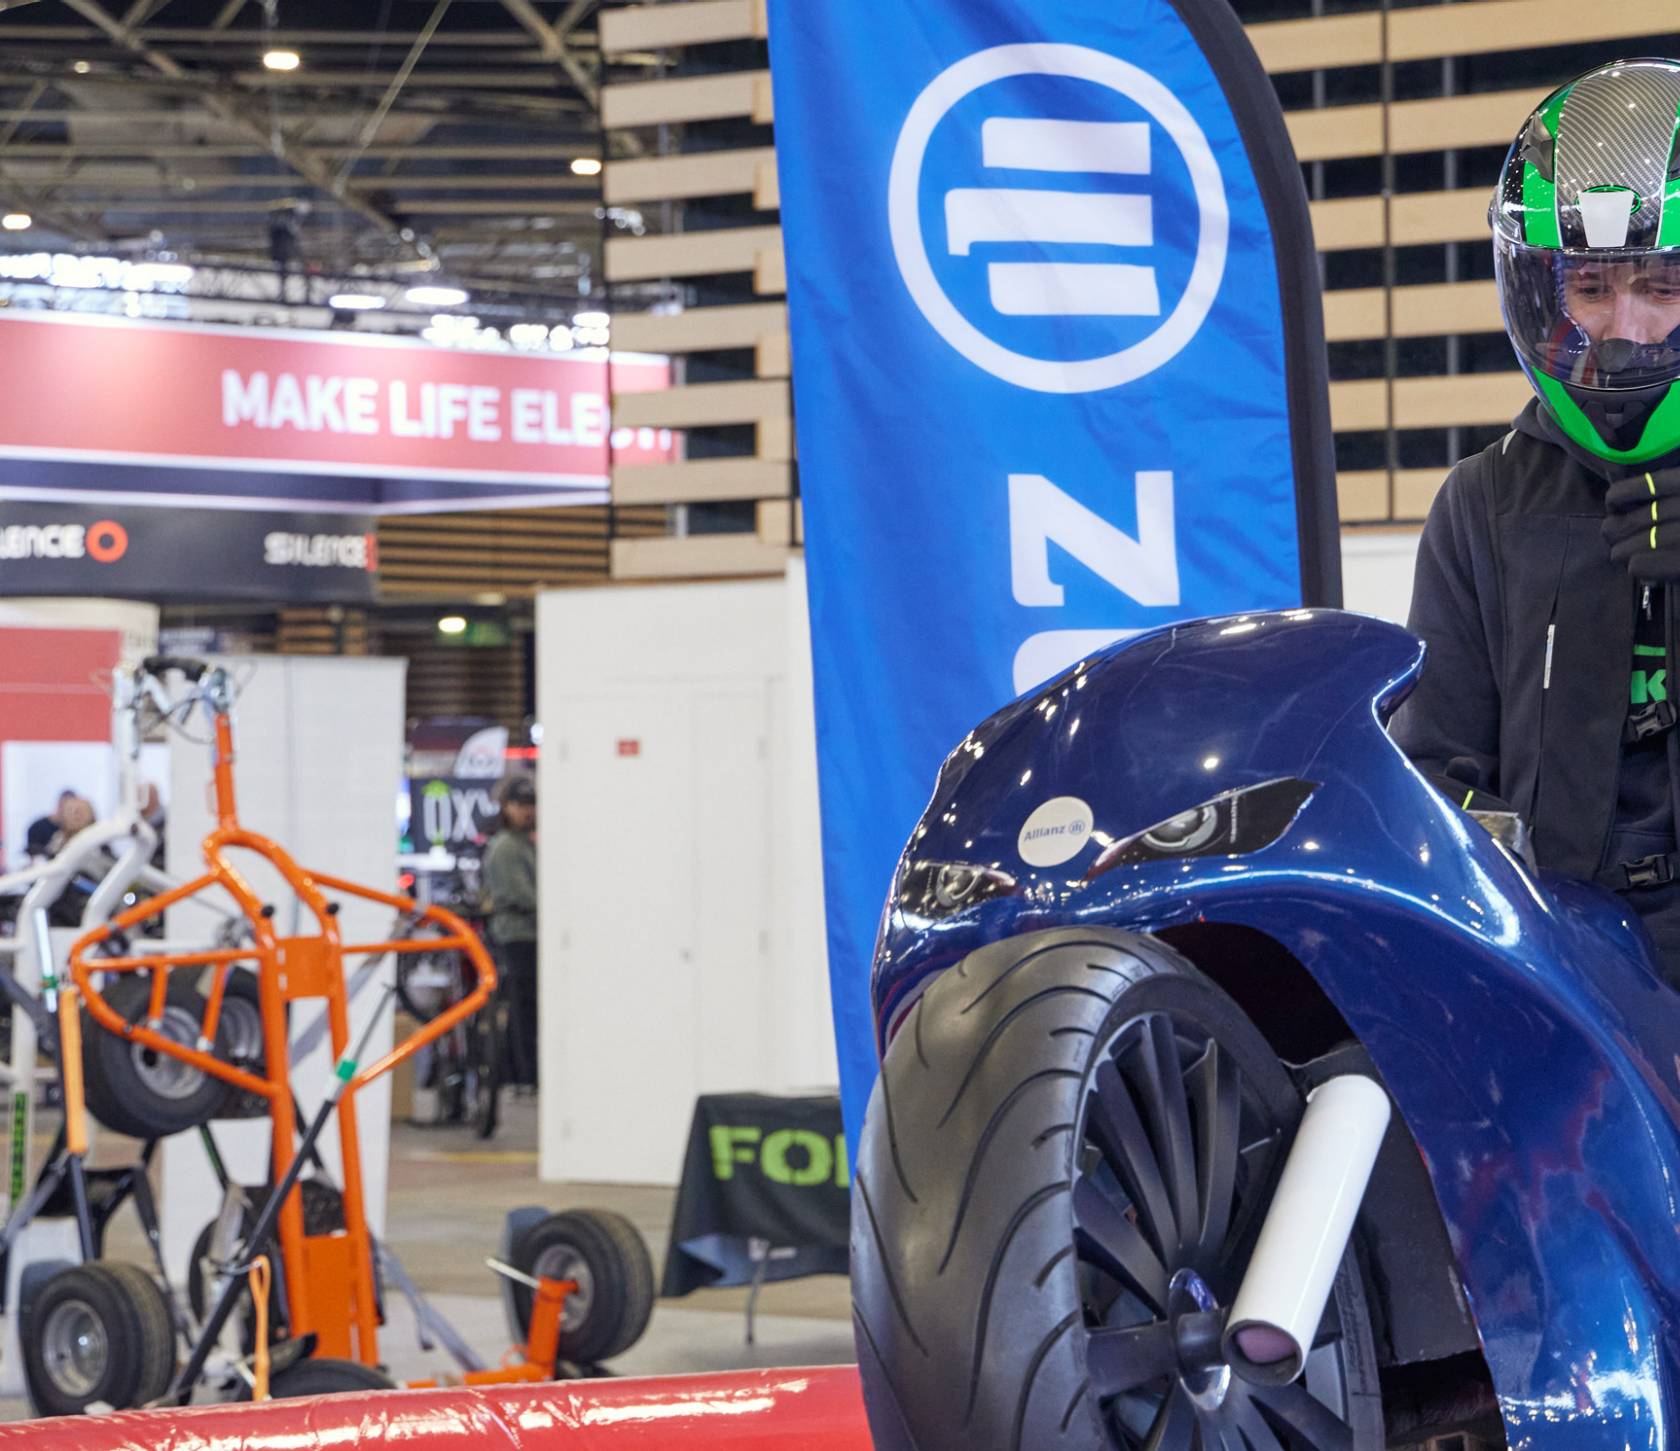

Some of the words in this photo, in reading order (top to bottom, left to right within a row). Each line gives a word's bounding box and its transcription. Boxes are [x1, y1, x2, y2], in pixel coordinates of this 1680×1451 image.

[221, 368, 380, 435] MAKE
[388, 380, 502, 441] LIFE
[1023, 825, 1067, 842] Allianz
